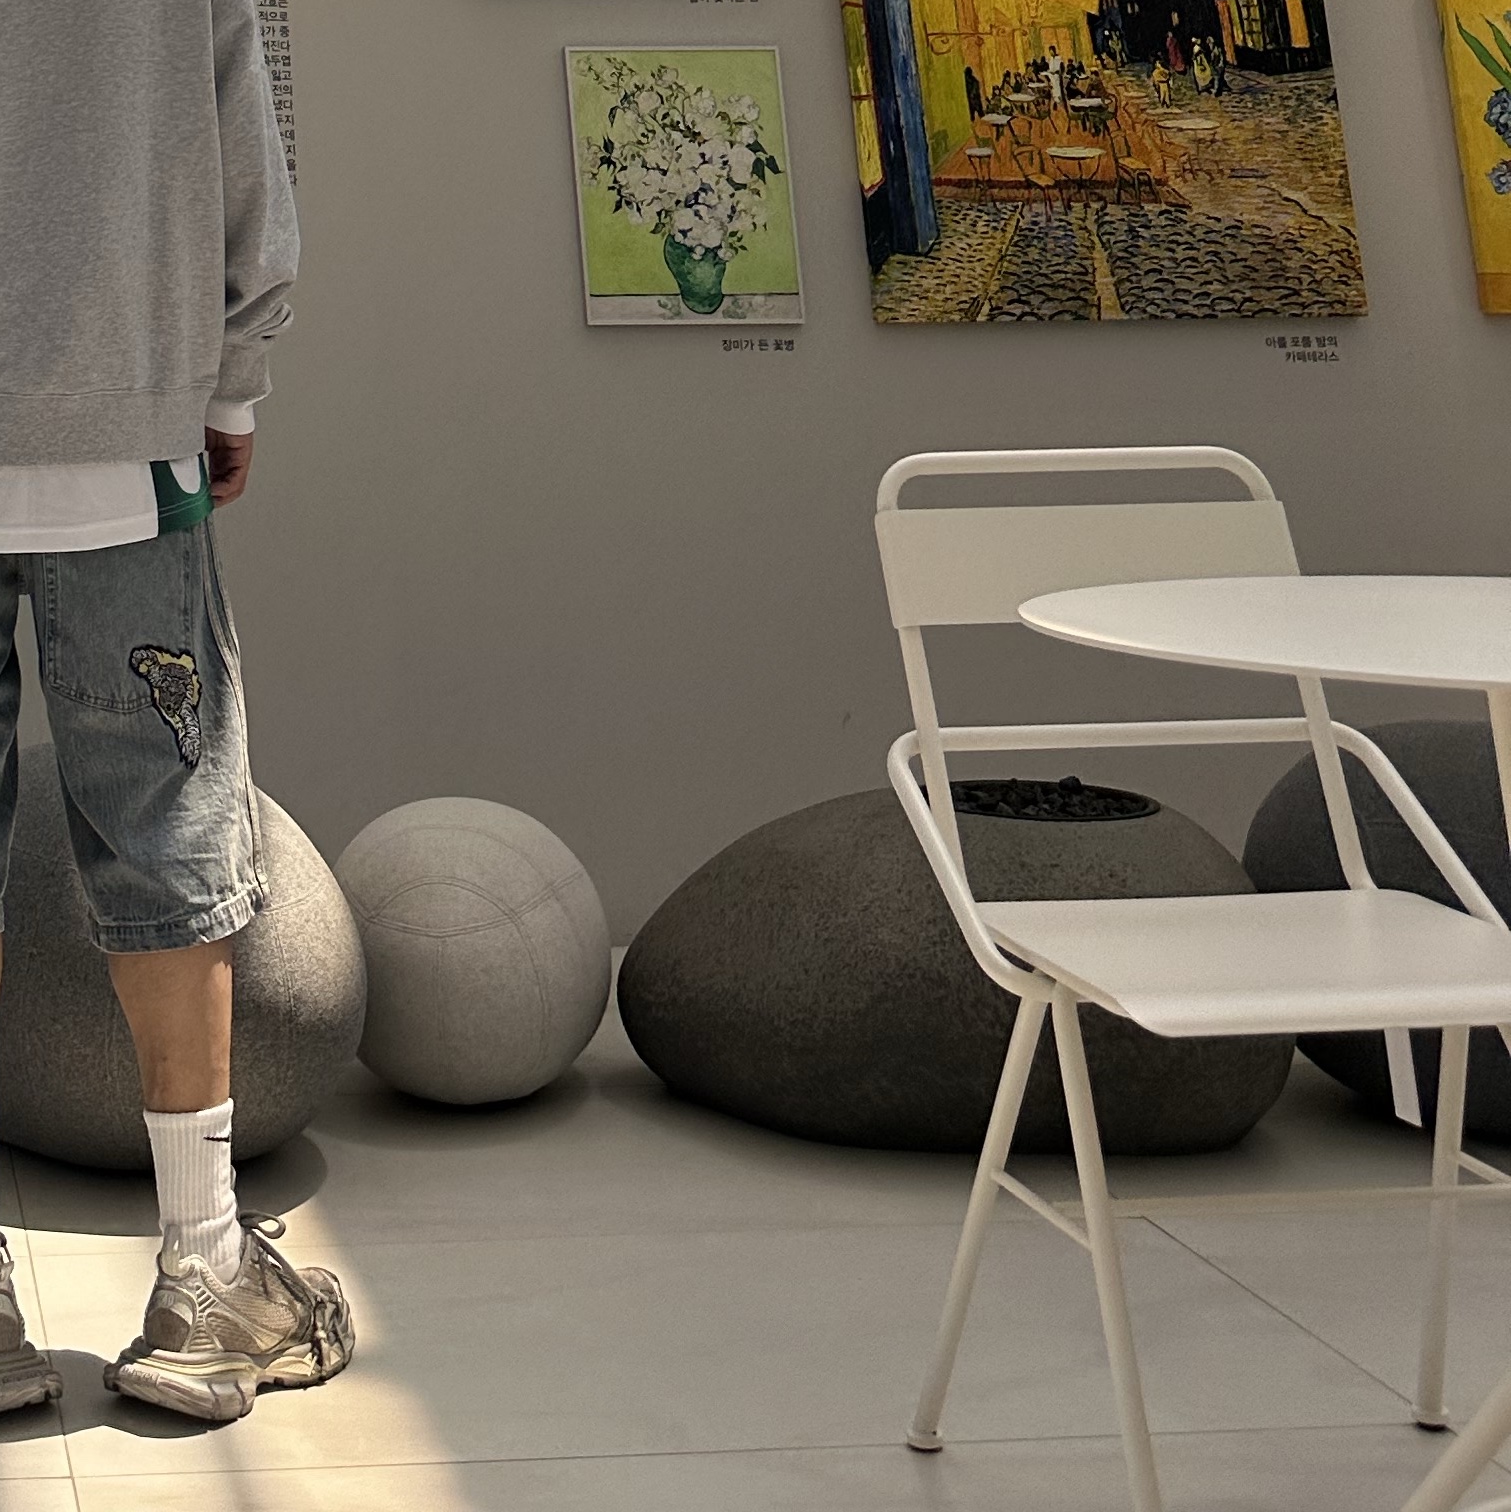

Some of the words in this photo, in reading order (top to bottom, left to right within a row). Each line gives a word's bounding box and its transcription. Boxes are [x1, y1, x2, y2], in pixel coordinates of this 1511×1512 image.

[721, 337, 755, 352] 장미가
[757, 338, 769, 352] 든
[773, 338, 795, 352] 꽃병
[1315, 335, 1339, 348] 밤의
[1285, 349, 1340, 363] 카페테라스
